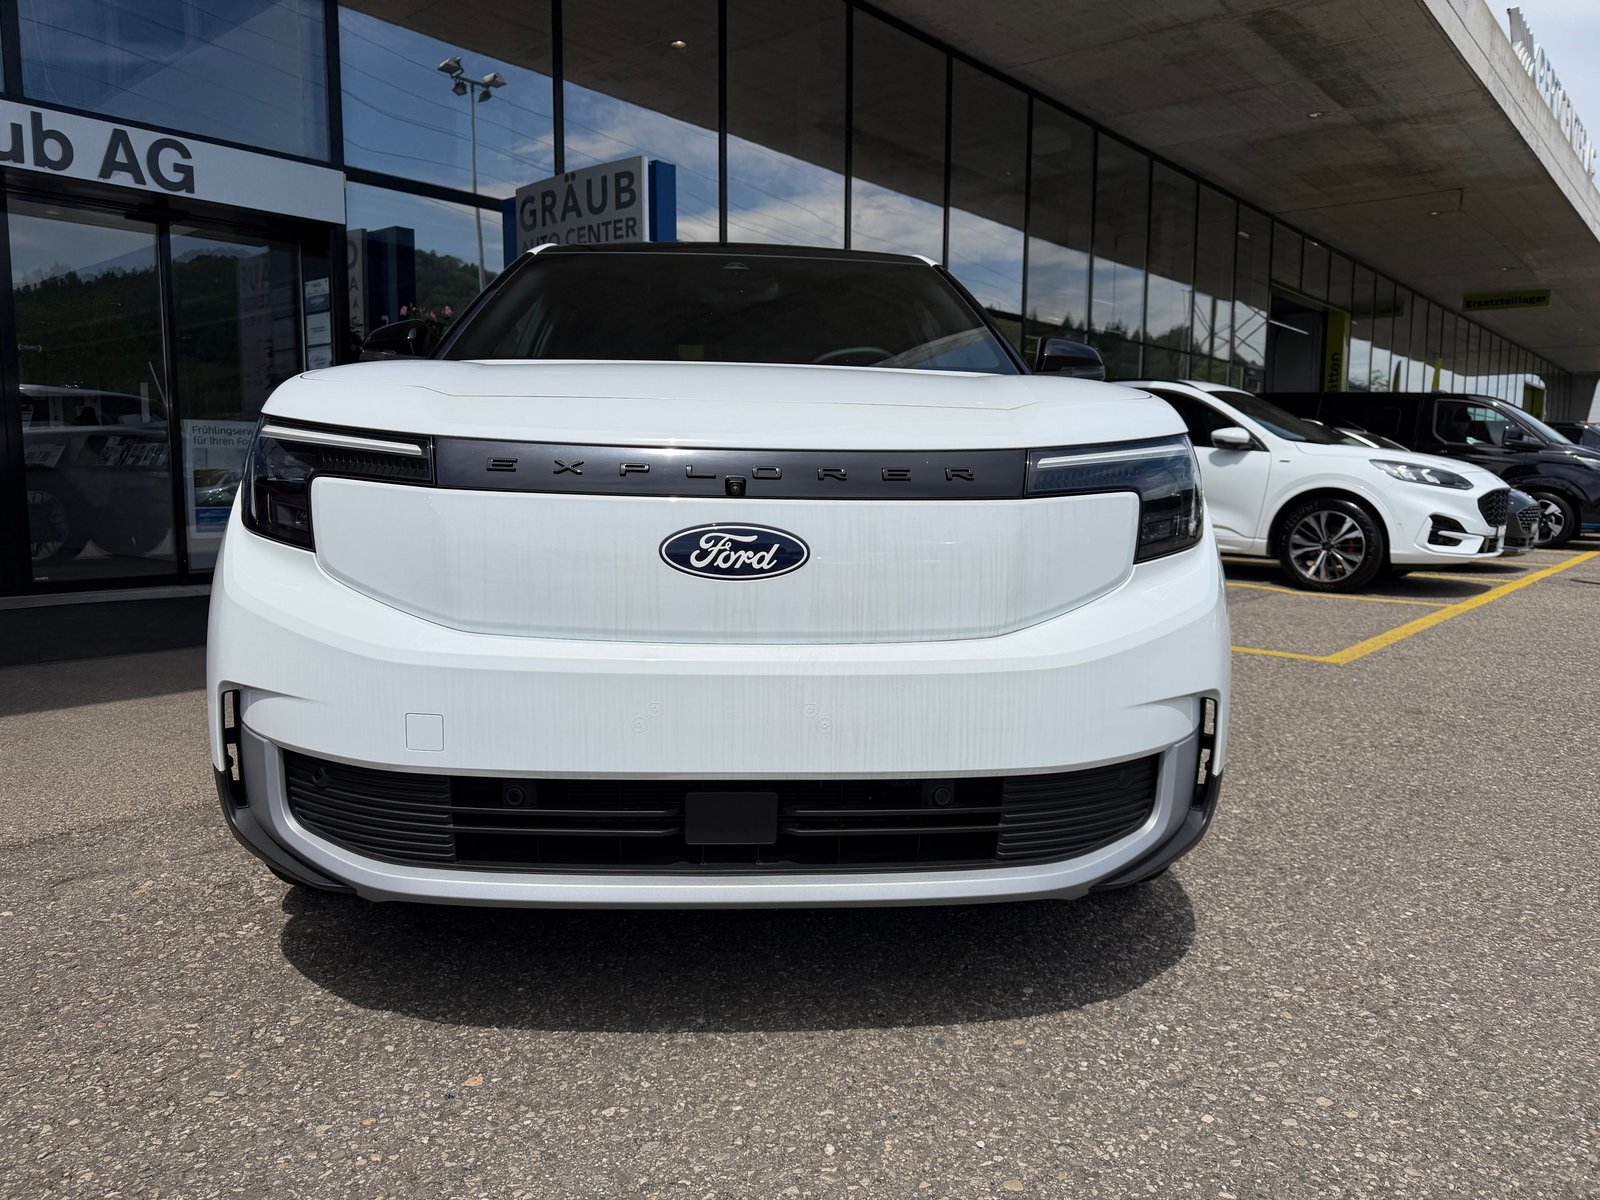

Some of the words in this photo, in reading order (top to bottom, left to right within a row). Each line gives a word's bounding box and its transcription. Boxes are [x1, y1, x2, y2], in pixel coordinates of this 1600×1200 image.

[98, 128, 195, 194] AG
[519, 170, 636, 233] GRÄUB
[566, 216, 637, 245] CENTER
[193, 436, 208, 446] für
[209, 436, 234, 446] Ihren
[486, 456, 976, 482] EXPLORER
[689, 532, 780, 570] Ford
